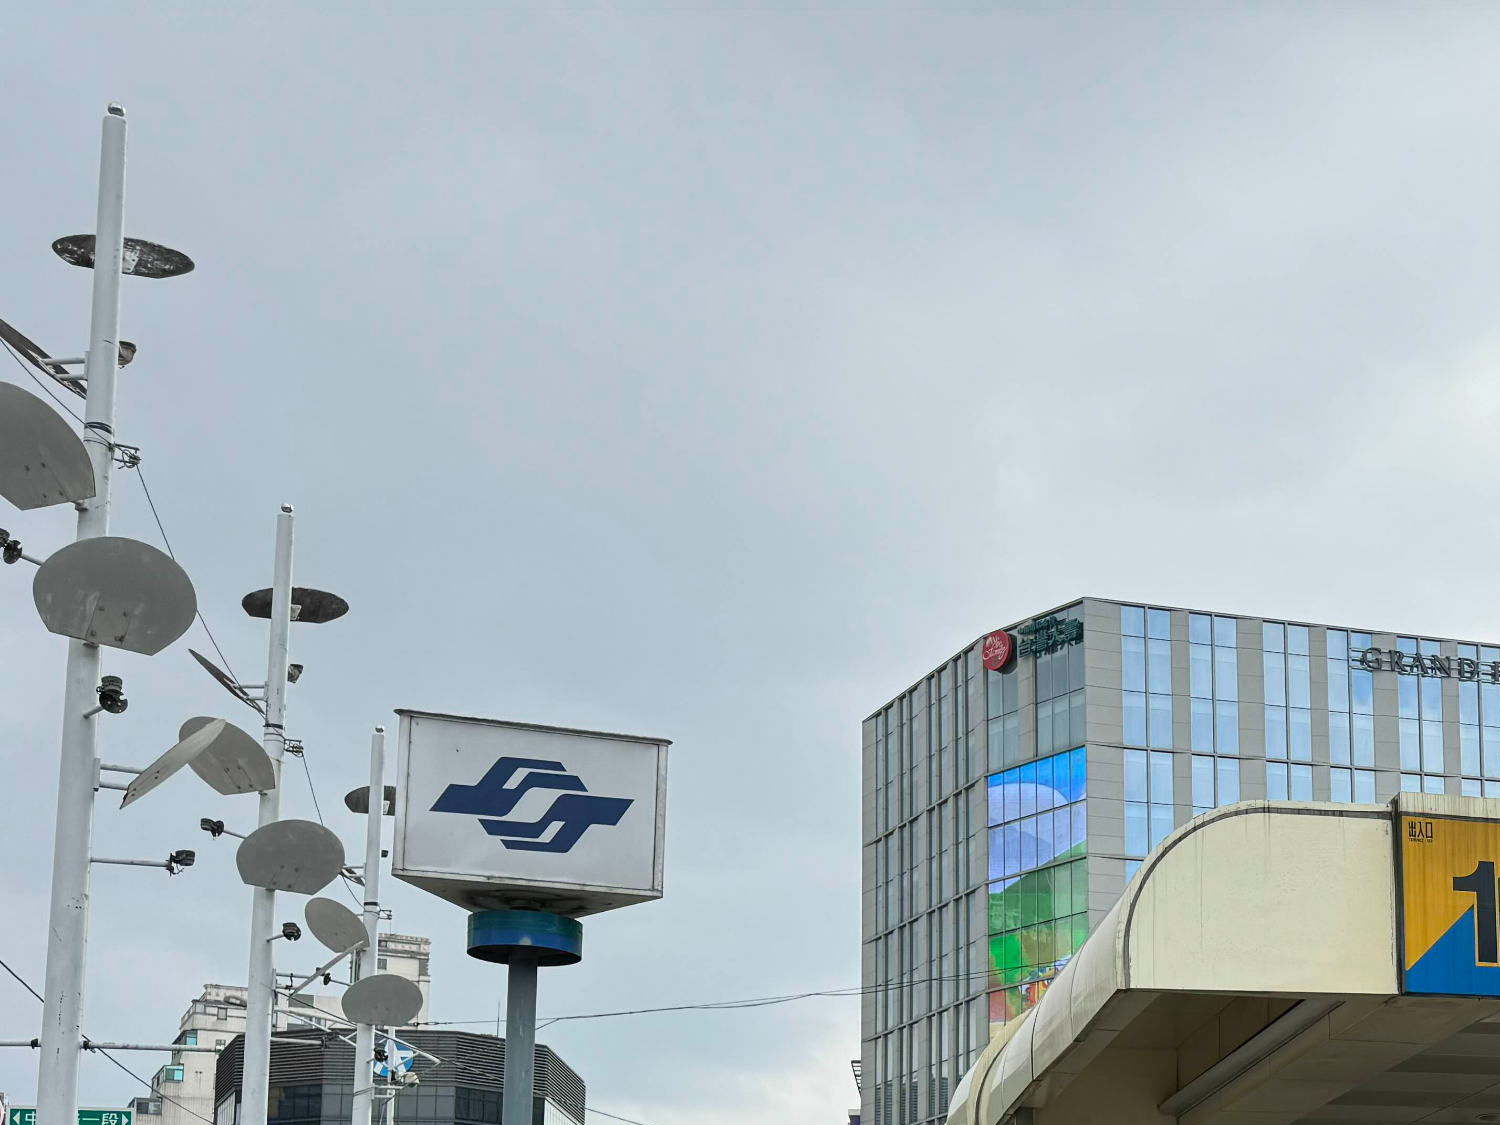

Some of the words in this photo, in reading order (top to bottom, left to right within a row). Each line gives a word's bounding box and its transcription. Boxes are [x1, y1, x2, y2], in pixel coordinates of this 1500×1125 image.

[1361, 647, 1478, 681] GRAND
[1408, 821, 1433, 839] 出入口
[1452, 860, 1500, 966] 1
